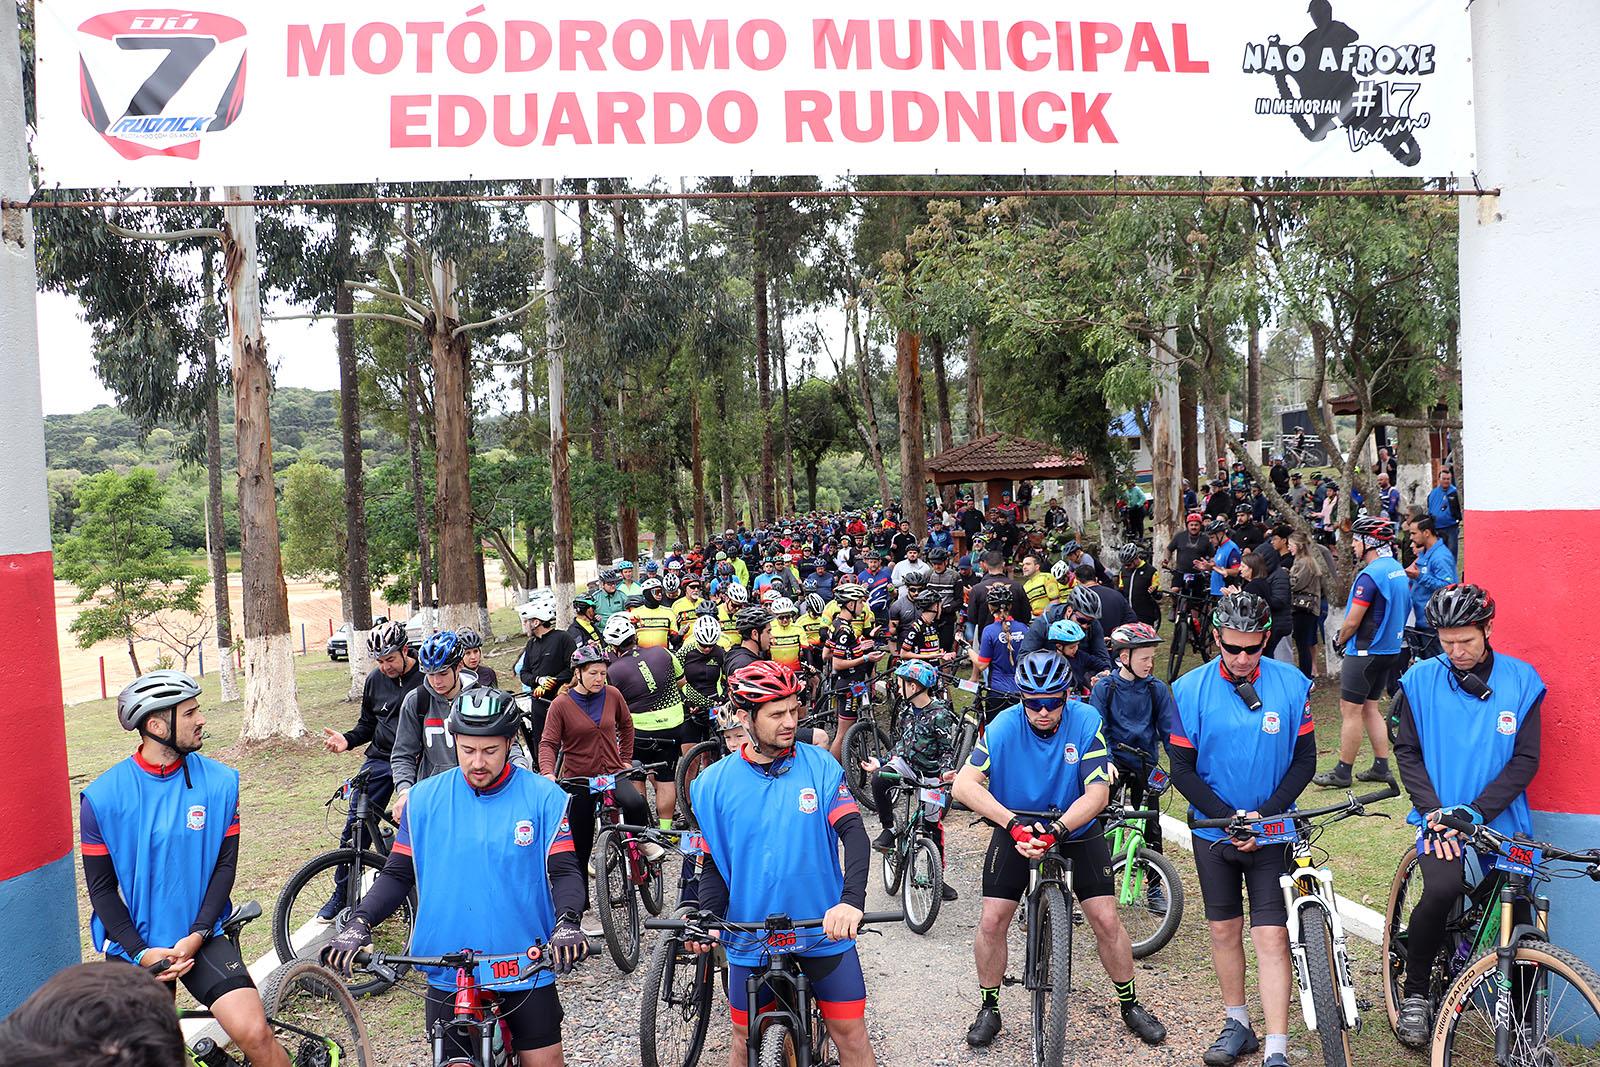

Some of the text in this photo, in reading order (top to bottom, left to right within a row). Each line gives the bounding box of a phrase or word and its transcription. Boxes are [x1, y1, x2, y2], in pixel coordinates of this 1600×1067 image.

[287, 4, 1209, 77] MOTÓDROMO MUNICIPAL
[1243, 34, 1436, 76] NÃO AFROXE
[115, 37, 216, 116] 7
[390, 90, 1118, 148] EDUARDO RUDNICK
[1255, 98, 1341, 115] IN MEMORIAN
[1351, 80, 1421, 118] #17
[113, 117, 212, 133] RUDNICK
[1348, 112, 1430, 152] Luciano
[490, 959, 520, 979] 105
[1449, 969, 1476, 1007] BARZO
[1495, 987, 1511, 1031] FOX
